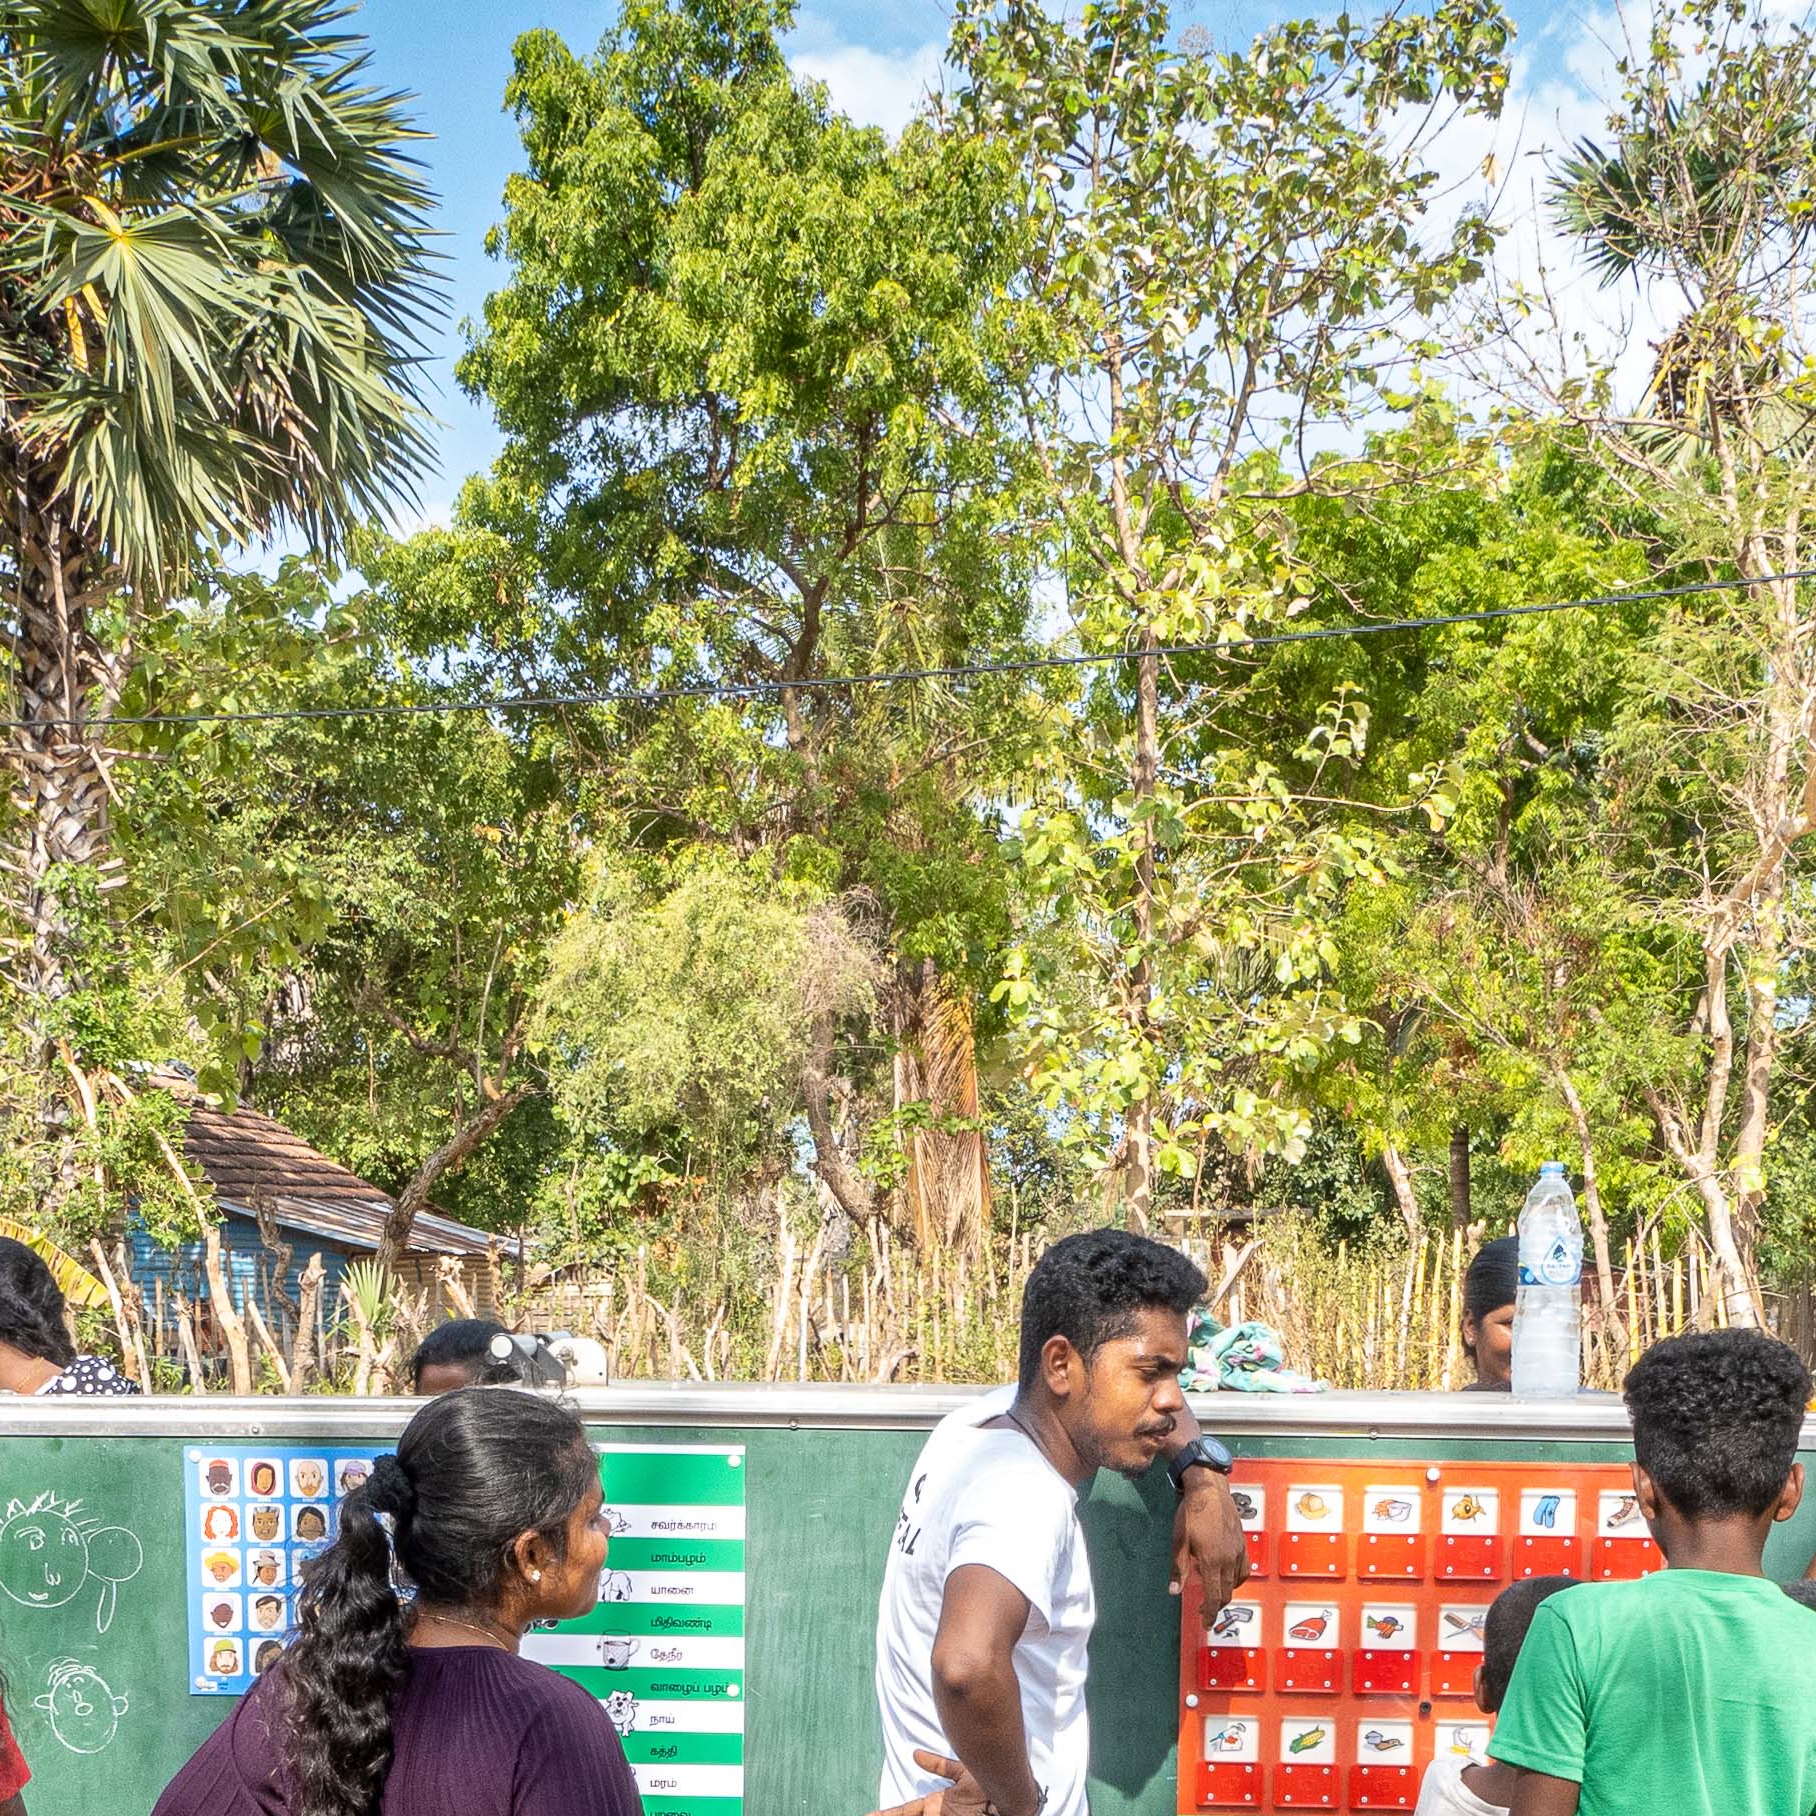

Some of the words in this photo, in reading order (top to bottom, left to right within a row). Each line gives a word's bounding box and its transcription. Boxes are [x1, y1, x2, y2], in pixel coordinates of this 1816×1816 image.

[650, 1554, 706, 1567] மாம்பழம்
[650, 1586, 694, 1596] யானை
[650, 1616, 713, 1630] மிதிவண்டி
[650, 1682, 700, 1697] வாழைப்
[649, 1714, 675, 1726] நாய்
[650, 1744, 678, 1759] கத்தி
[650, 1777, 677, 1789] மரம்
